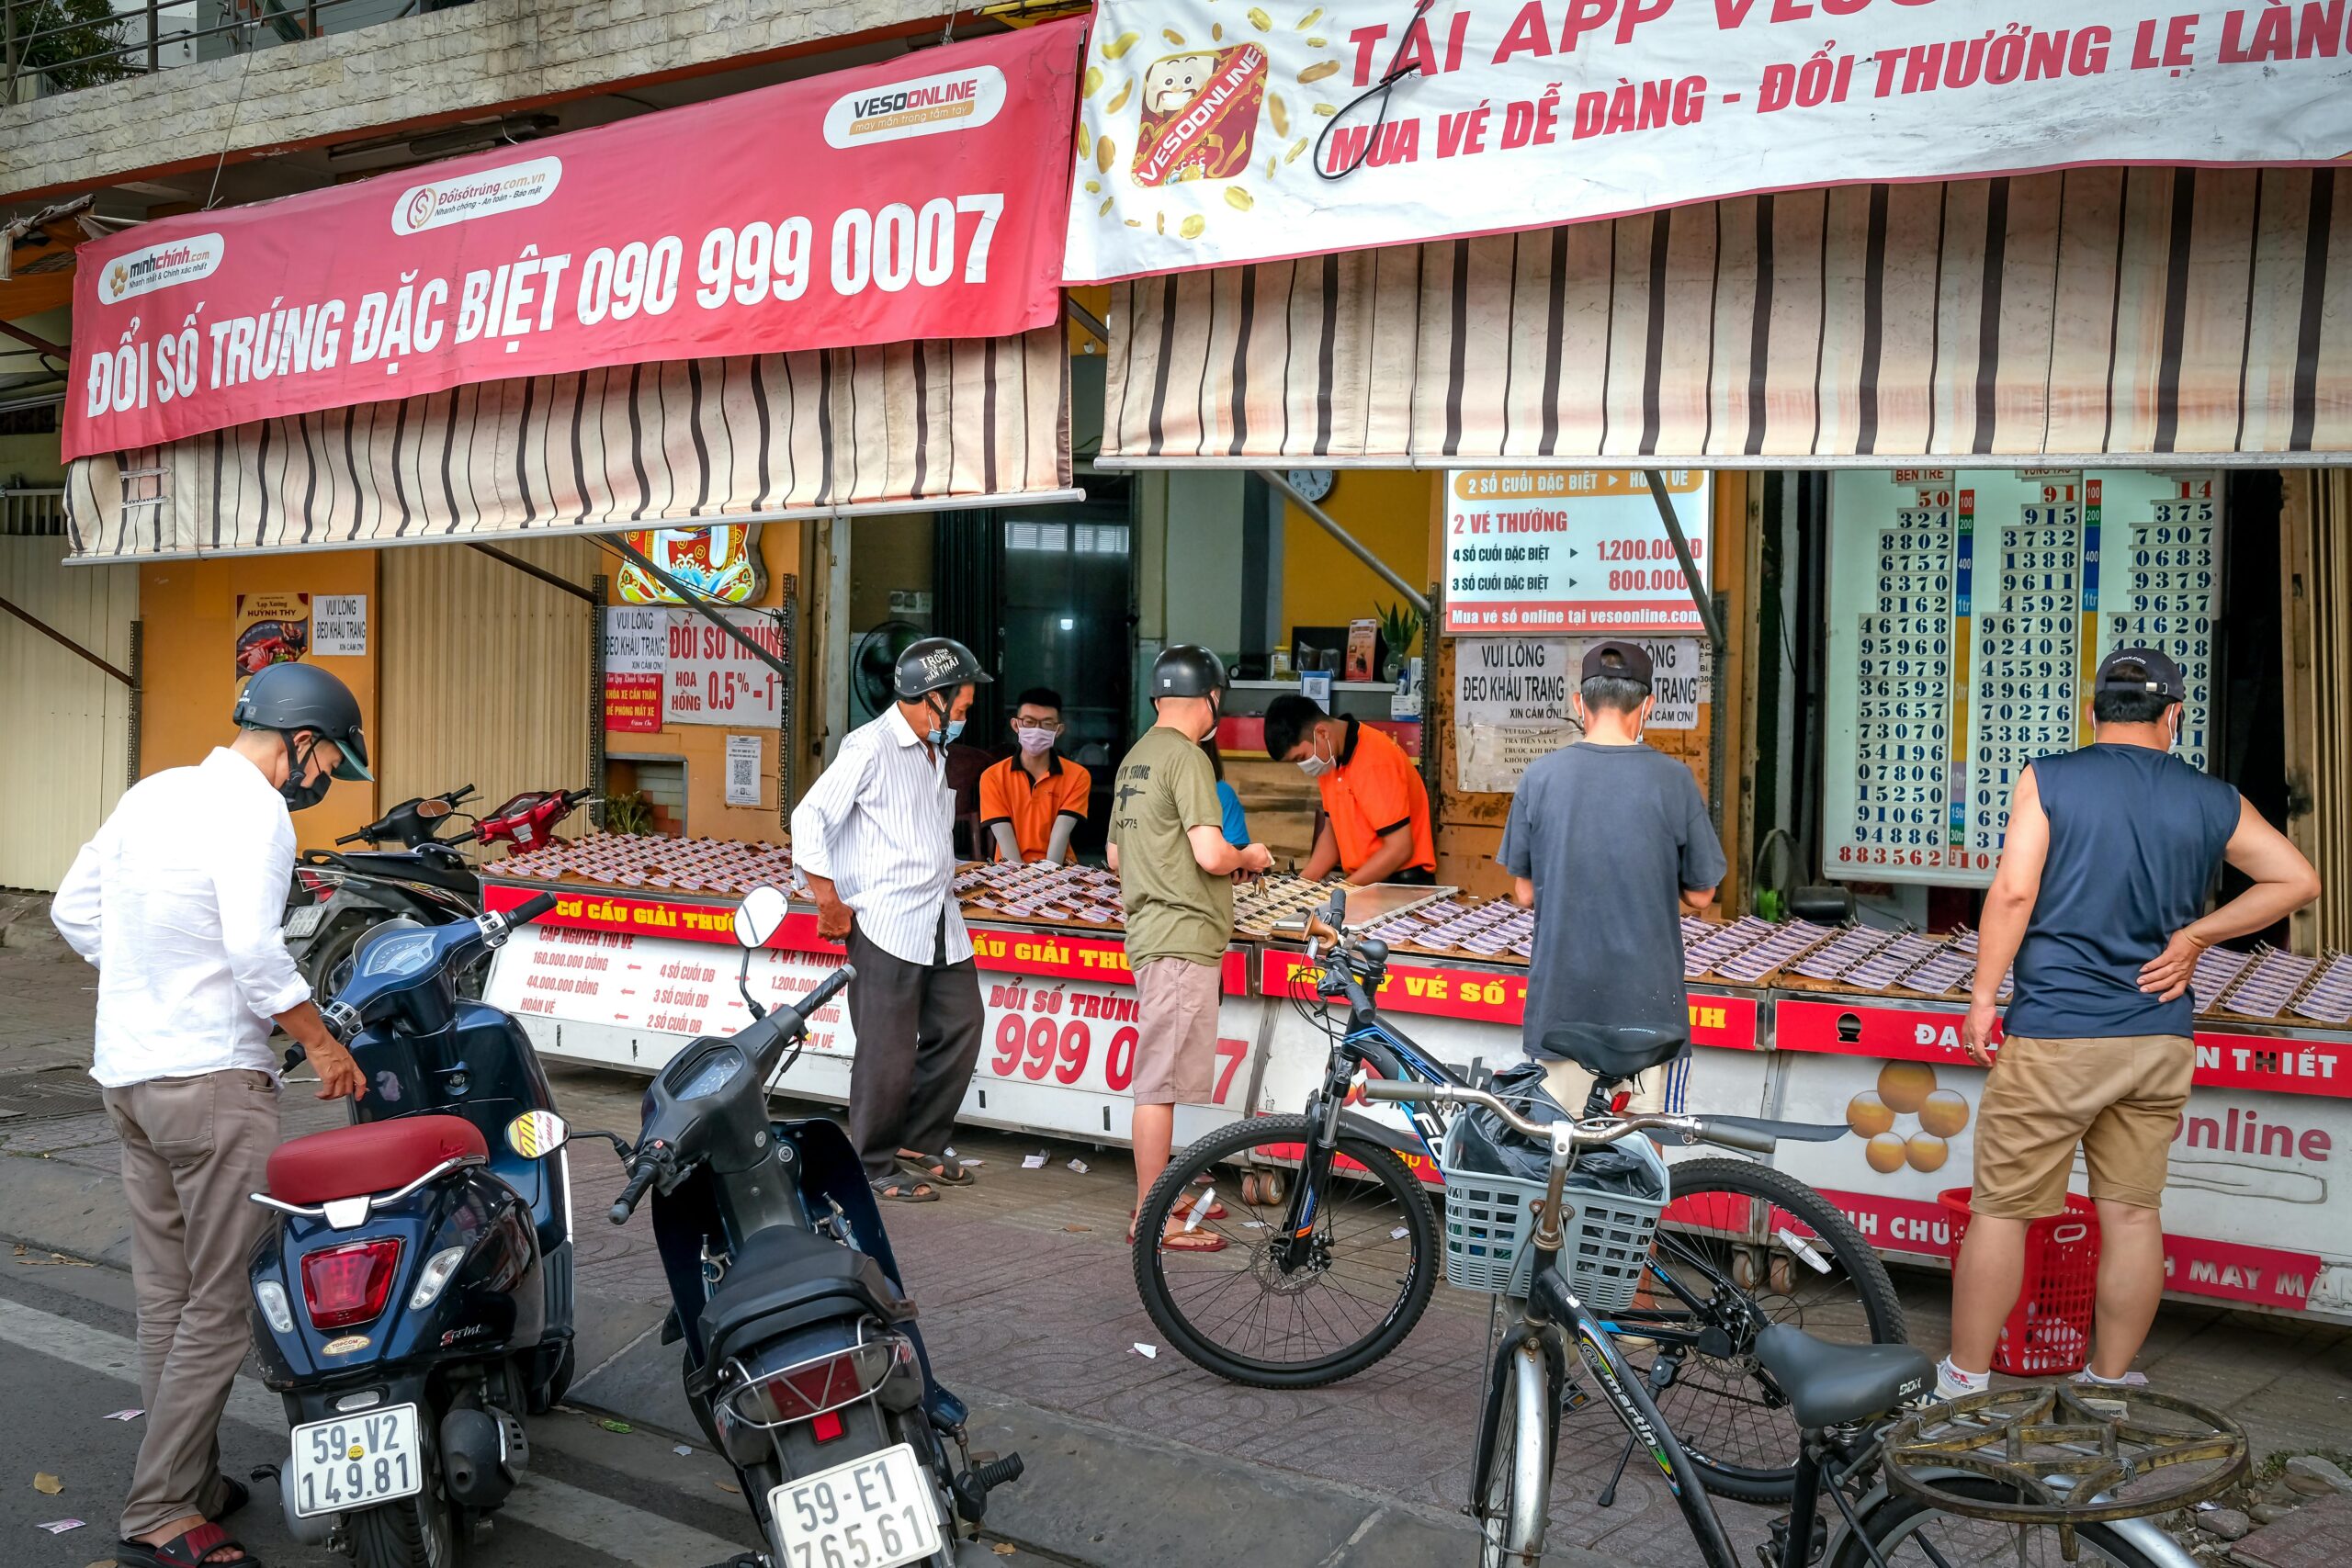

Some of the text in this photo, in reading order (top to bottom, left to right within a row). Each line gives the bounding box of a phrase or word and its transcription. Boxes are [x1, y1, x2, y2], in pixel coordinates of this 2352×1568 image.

[1491, 0, 1675, 65] APP
[1326, 0, 2352, 174] MUA VÉ DỄ DÀNG ĐỔI THƯỞNG LẸ LÀN
[854, 79, 978, 118] VESOONLINE
[855, 120, 875, 131] may
[901, 112, 927, 122] trong
[952, 105, 967, 116] tay
[1138, 46, 1262, 181] VESOONLINE
[435, 206, 456, 217] Nhanh
[481, 197, 492, 206] An
[130, 277, 145, 289] Nhanh
[158, 272, 162, 280] &
[87, 193, 1004, 418] ĐỔI SỐ TRÚNG ĐẶC BIỆT 090 999 0007
[1469, 479, 1476, 493] 2
[1537, 474, 1564, 495] ĐẶC
[1569, 473, 1598, 493] BIỆT
[2043, 485, 2075, 502] 91
[2181, 480, 2211, 499] 14
[1918, 491, 1949, 507] 50
[1961, 495, 1973, 508] 100
[1453, 508, 1567, 535] 2 VÉ THƯỞNG
[1900, 513, 1949, 529] 324
[1960, 519, 1973, 530] 200
[2025, 507, 2076, 525] 915
[2136, 527, 2212, 544] 7907
[1453, 538, 1702, 563] 4 SỐ CUỐI ĐẶC BIỆT 1.200.00Đ
[1881, 555, 1949, 571] 6757
[1958, 558, 1971, 570] 400
[1453, 570, 1702, 592] 3 SỐ CUỐI ĐẶC BIỆT 800.000
[326, 597, 356, 615] VUI LÒNG
[1957, 598, 1971, 613] 1tr
[616, 608, 653, 629] VUI LÒNG
[1452, 607, 1702, 626] Mua vé số online tại vesoonline.com
[1860, 617, 1947, 634] 46768
[1982, 617, 2073, 634] 96790
[2114, 617, 2209, 634] 94620
[317, 622, 328, 638] ĐEO
[346, 622, 366, 638] TRANG
[670, 612, 697, 660] ĐỔI
[641, 637, 665, 656] TRANG
[1482, 639, 1544, 667] VUI LÒNG
[1860, 660, 1946, 676] 97979
[1981, 660, 2073, 677] 45593
[675, 671, 696, 687] HOA
[1464, 676, 1487, 701] ĐEO
[1525, 676, 1564, 701] TRANG
[621, 690, 628, 699] XE
[1655, 678, 1696, 704] TRANG
[648, 707, 654, 716] XE
[672, 693, 701, 711] HỒNG
[1510, 706, 1544, 718] XIN CẢM
[1656, 708, 1692, 721] CẢM ƠN!
[1860, 724, 1944, 739] 73070
[1981, 726, 2071, 742] 53852
[1856, 827, 1939, 845] 94886
[1839, 846, 1940, 866] 883562
[557, 900, 735, 932] CƠ CẤU GIẢI THƯ
[602, 934, 618, 948] 110
[974, 933, 1069, 964] ẤU GIẢI
[534, 951, 608, 971] 160.000.000 ĐỒNG
[660, 961, 716, 983] 4 SỐ CUỐI ĐB
[526, 976, 599, 995] 44.000.000 ĐỒNG
[772, 976, 817, 993] 1.200.000
[1405, 976, 1506, 1005] VÉ SỐ
[653, 986, 709, 1008] 3 SỐ CUỐI ĐB
[989, 976, 1028, 1010] ĐỔI
[1033, 984, 1066, 1014] SỐ
[521, 997, 556, 1014] HOÀN VÉ
[647, 1010, 702, 1033] 2 SỐ CUỐI ĐB
[822, 1031, 834, 1048] VÉ
[1915, 1023, 1960, 1053] ĐẠ
[991, 1013, 1091, 1085] 999
[2232, 1047, 2337, 1077] THIẾT
[1890, 1218, 1950, 1245] CHÚ
[2189, 1260, 2261, 1290] MAY
[1604, 1374, 1657, 1446] martin
[312, 1415, 399, 1464] 59-V2
[302, 1453, 409, 1508] 149.81
[792, 1461, 897, 1532] 59-E1
[794, 1505, 924, 1568] 765.61
